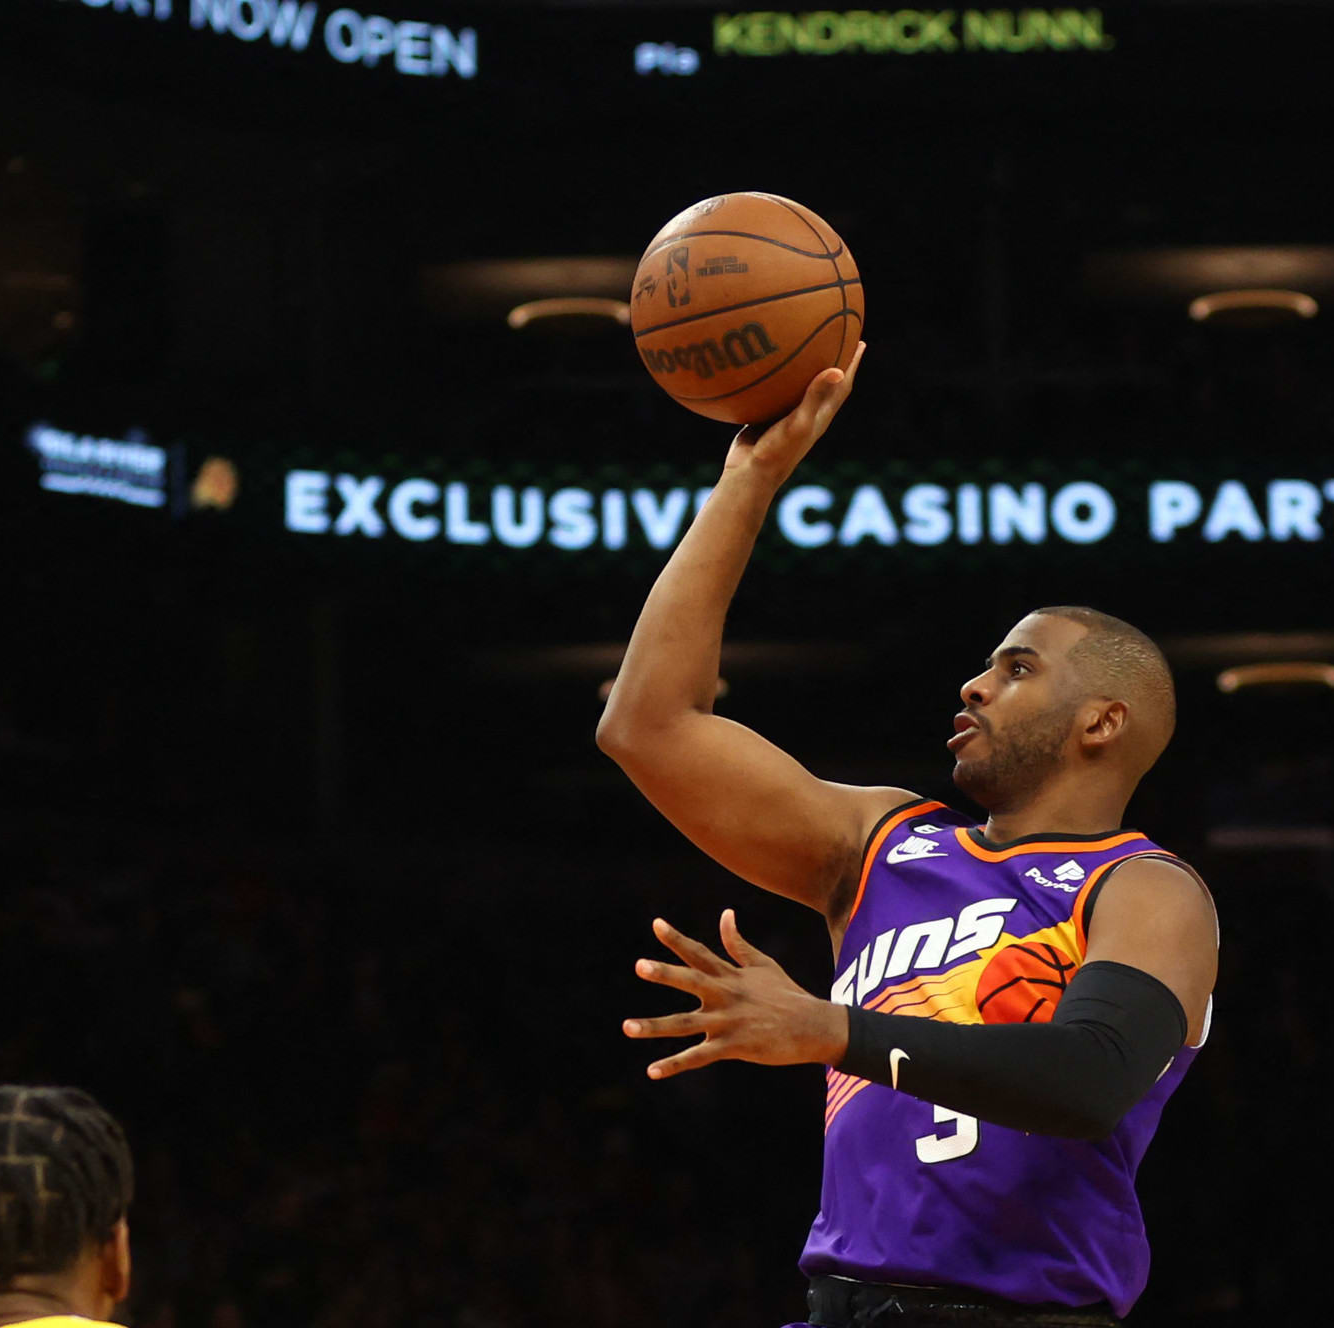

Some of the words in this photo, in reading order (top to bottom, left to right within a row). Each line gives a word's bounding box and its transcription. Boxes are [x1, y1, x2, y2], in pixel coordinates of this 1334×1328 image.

[324, 9, 479, 79] OPEN
[713, 9, 958, 55] KENDRICK
[284, 470, 717, 550] EXCLUSIV
[778, 481, 1116, 547] CASINO
